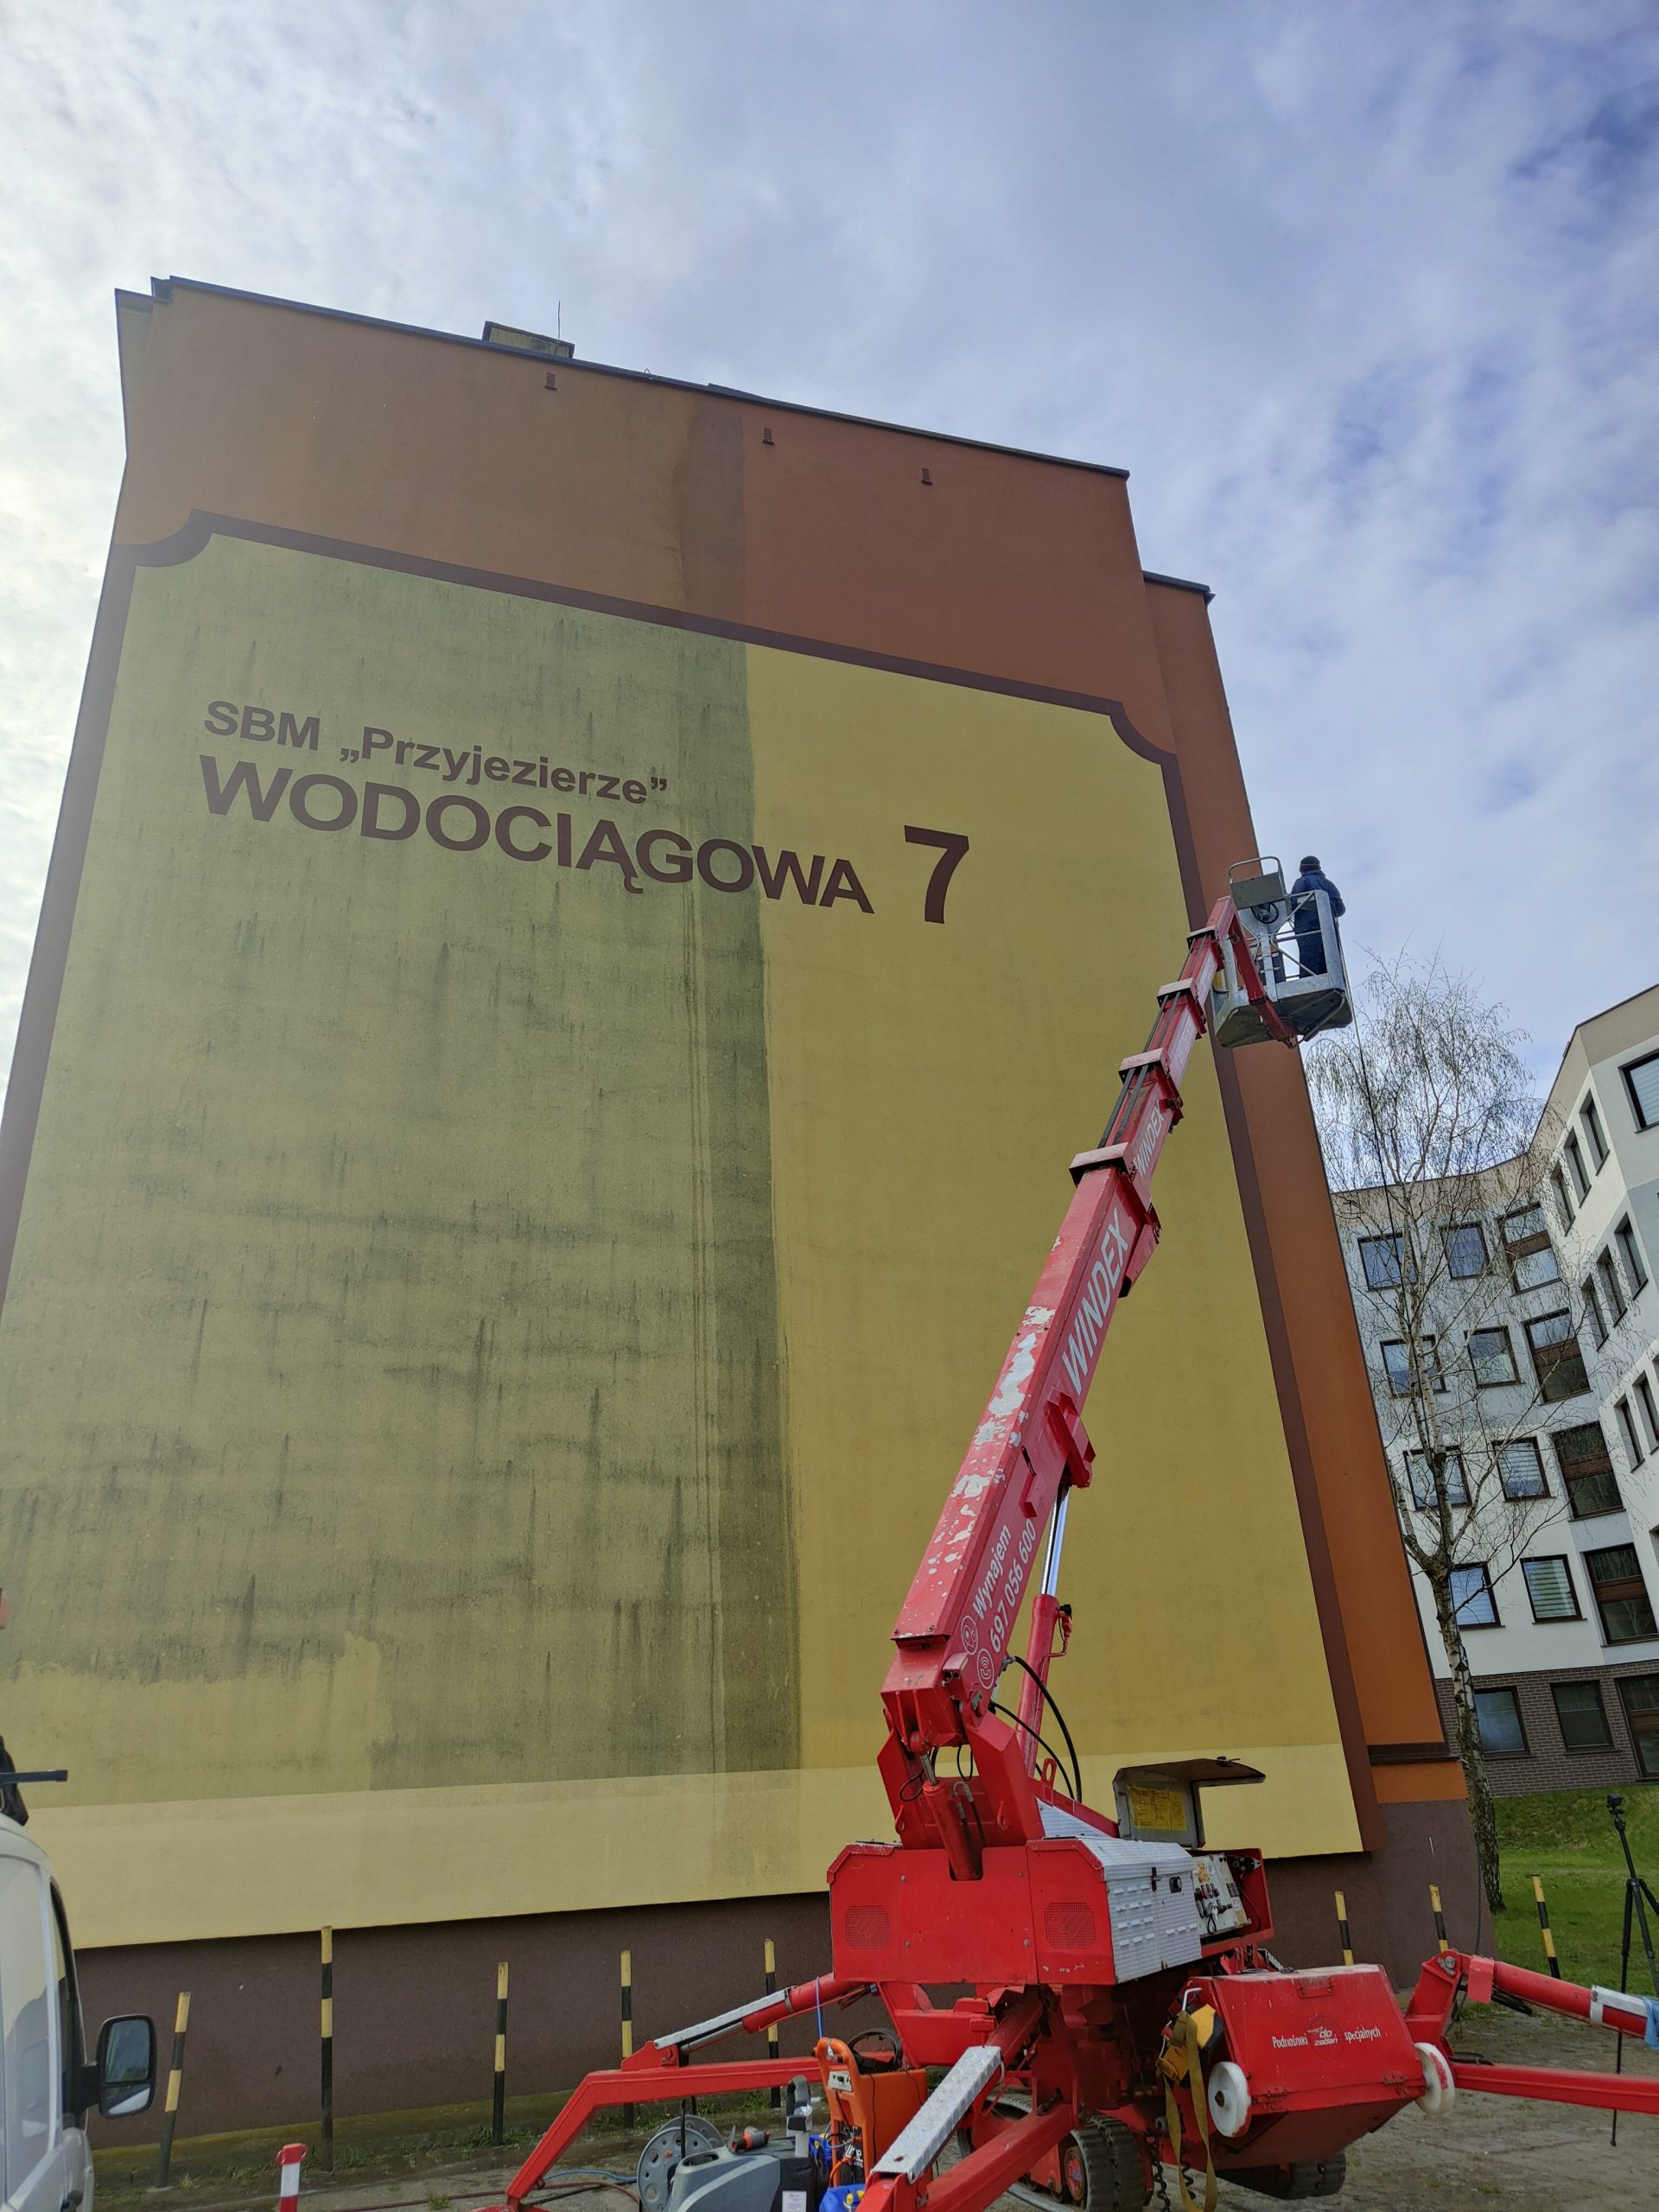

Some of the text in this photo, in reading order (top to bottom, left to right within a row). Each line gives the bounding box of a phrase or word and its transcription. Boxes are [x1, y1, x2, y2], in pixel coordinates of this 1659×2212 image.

[204, 701, 668, 804] SBM „Przyjezierze”
[200, 754, 969, 924] WODOCIĄGOWA 7
[1133, 1098, 1164, 1179] WINDEX
[1062, 1207, 1128, 1395] WINDEX
[972, 1524, 1012, 1621] Wynajem
[990, 1518, 1036, 1653] 697 056 600
[1319, 2029, 1332, 2038] do
[1344, 2024, 1381, 2044] specjalnych
